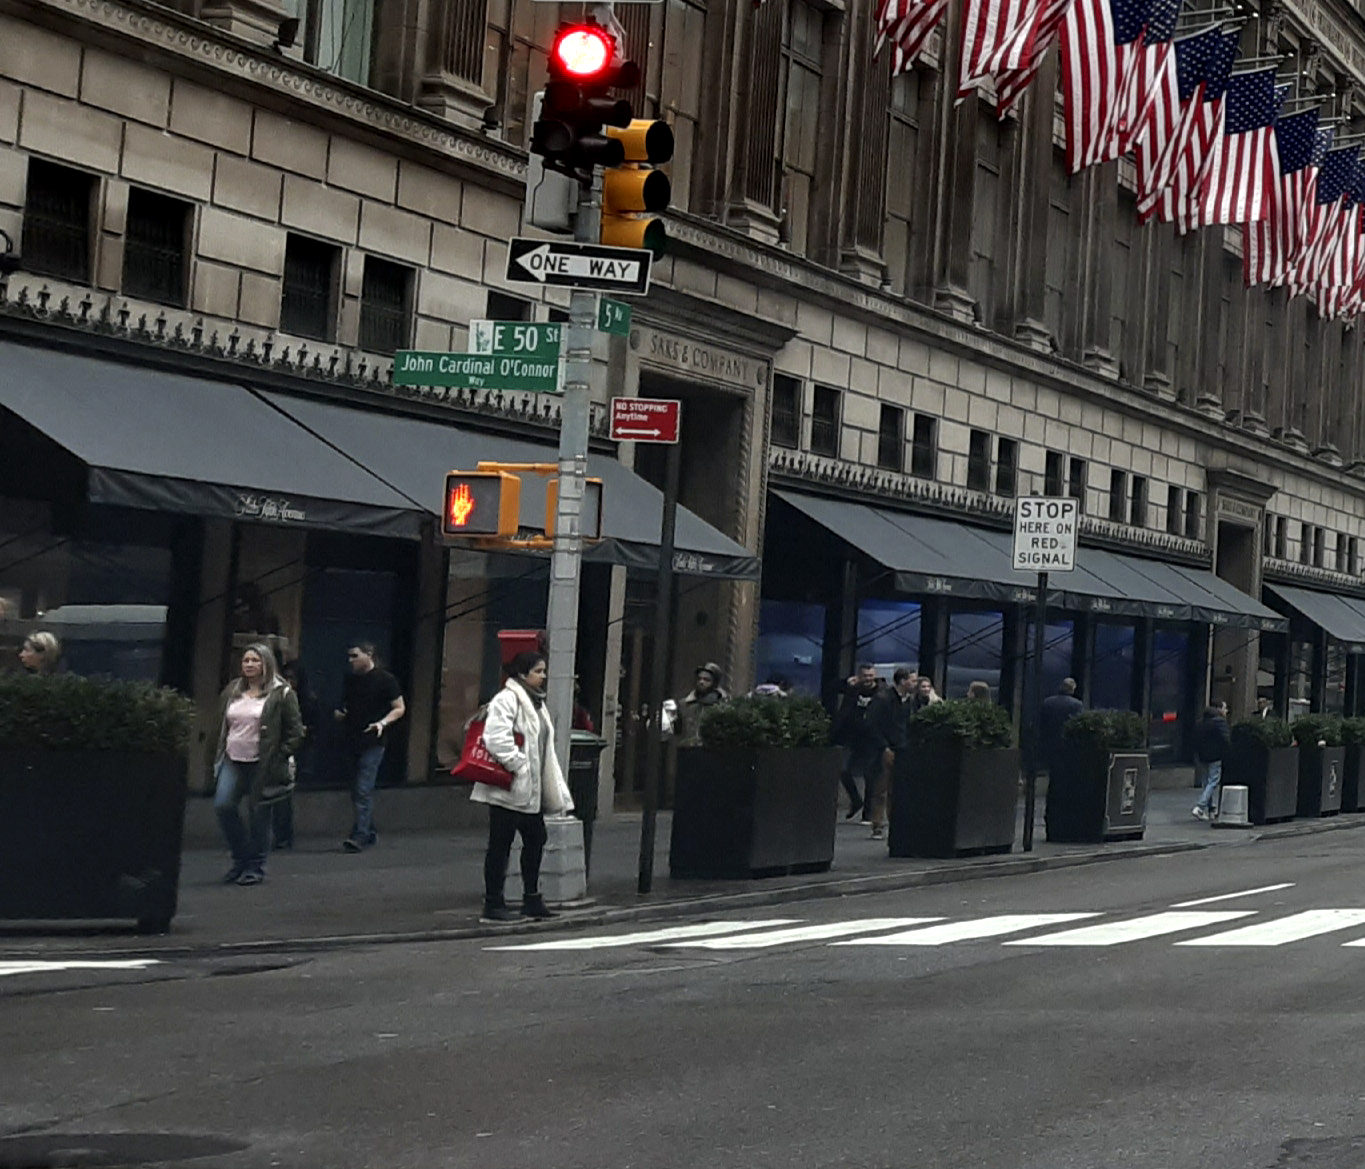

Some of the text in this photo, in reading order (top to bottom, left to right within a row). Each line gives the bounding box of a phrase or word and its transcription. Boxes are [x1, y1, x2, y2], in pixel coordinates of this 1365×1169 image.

[529, 253, 631, 279] ONE WAY
[604, 303, 612, 328] 5
[493, 325, 559, 352] E 50 St
[650, 334, 680, 361] SAKS
[401, 353, 555, 378] John Cardinal O'Connor
[468, 375, 485, 387] Way
[615, 402, 669, 413] NO STOPPING
[615, 412, 649, 422] Anytime
[1020, 501, 1074, 519] STOP
[1019, 521, 1073, 535] HERE ON
[1031, 537, 1059, 550] RED
[1018, 552, 1071, 566] SIGNAL
